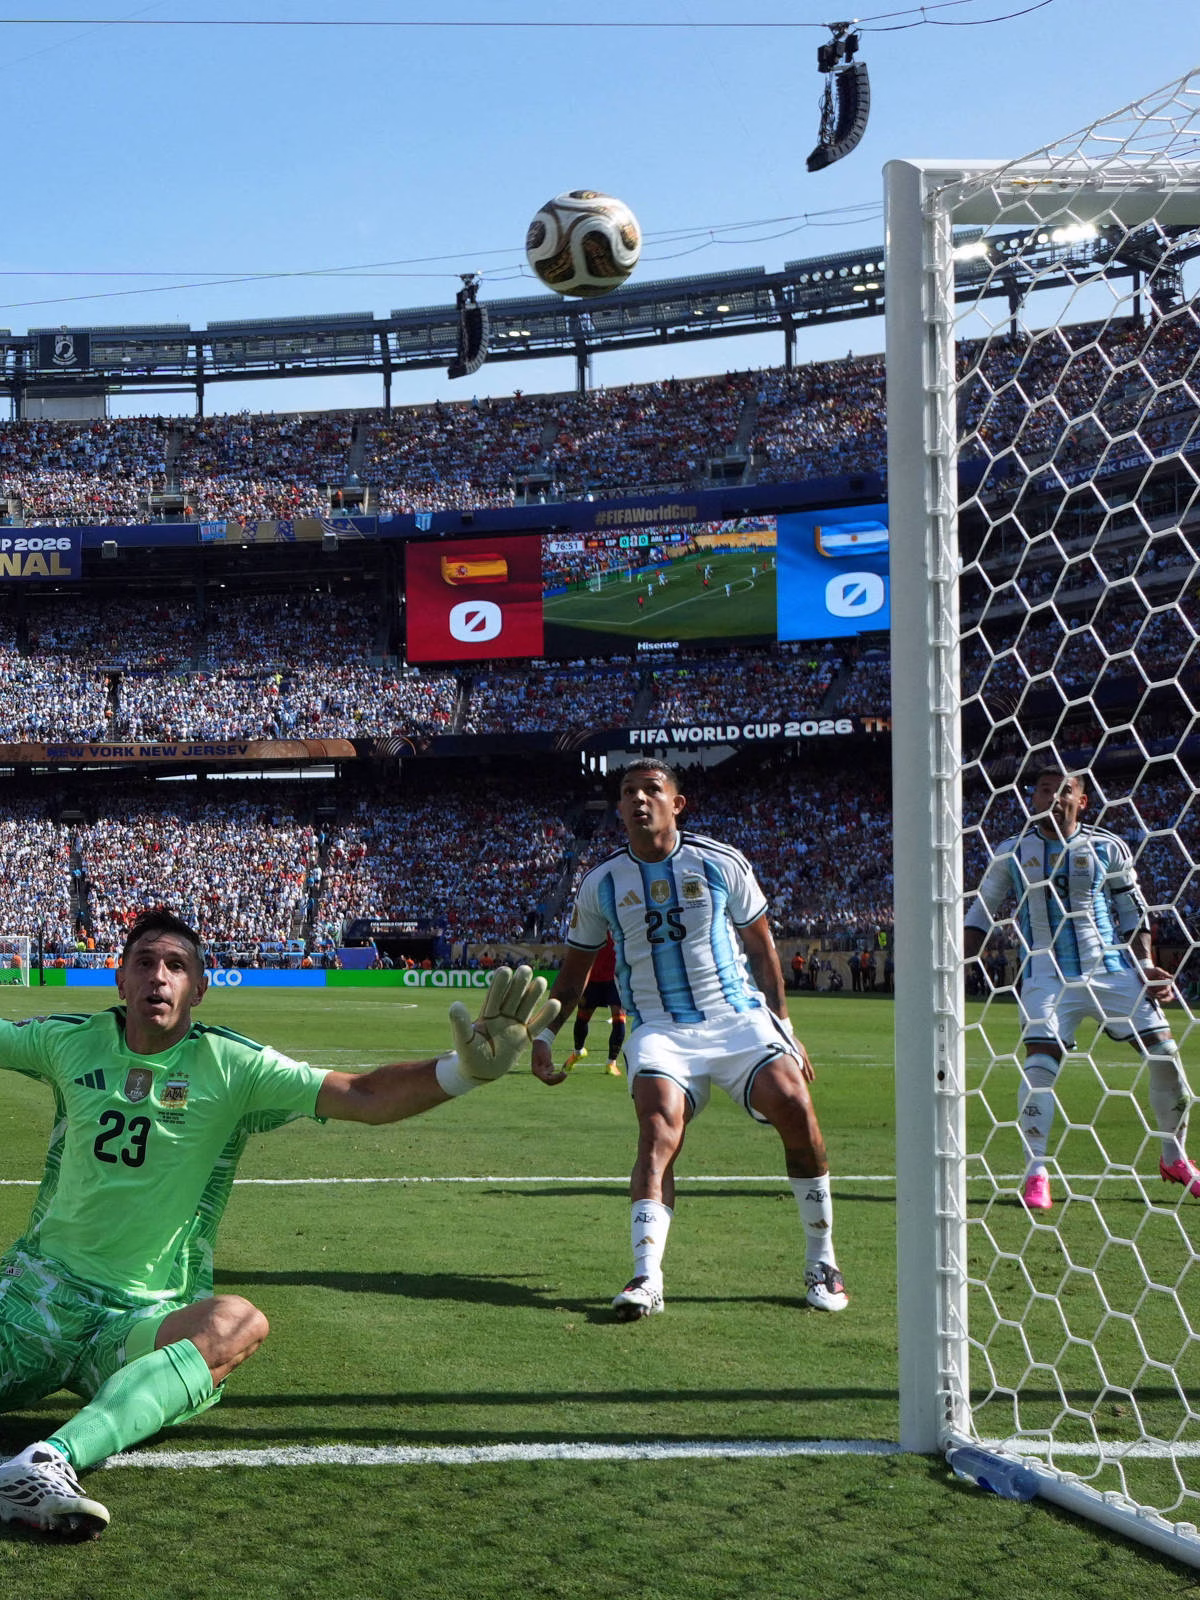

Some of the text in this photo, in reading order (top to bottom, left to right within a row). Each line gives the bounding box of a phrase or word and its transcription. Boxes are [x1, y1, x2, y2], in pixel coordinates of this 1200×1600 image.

[1119, 456, 1154, 471] NEW
[595, 504, 697, 526] #FIFAWorldCup
[14, 537, 72, 551] 2026
[555, 541, 579, 551] 76:51
[637, 640, 679, 651] Hisense
[629, 717, 892, 745] FIFA WORLD CUP 2026 TH
[47, 745, 249, 758] NEW YORK NEW JERSEY
[645, 907, 686, 944] 25
[94, 1109, 151, 1168] 23
